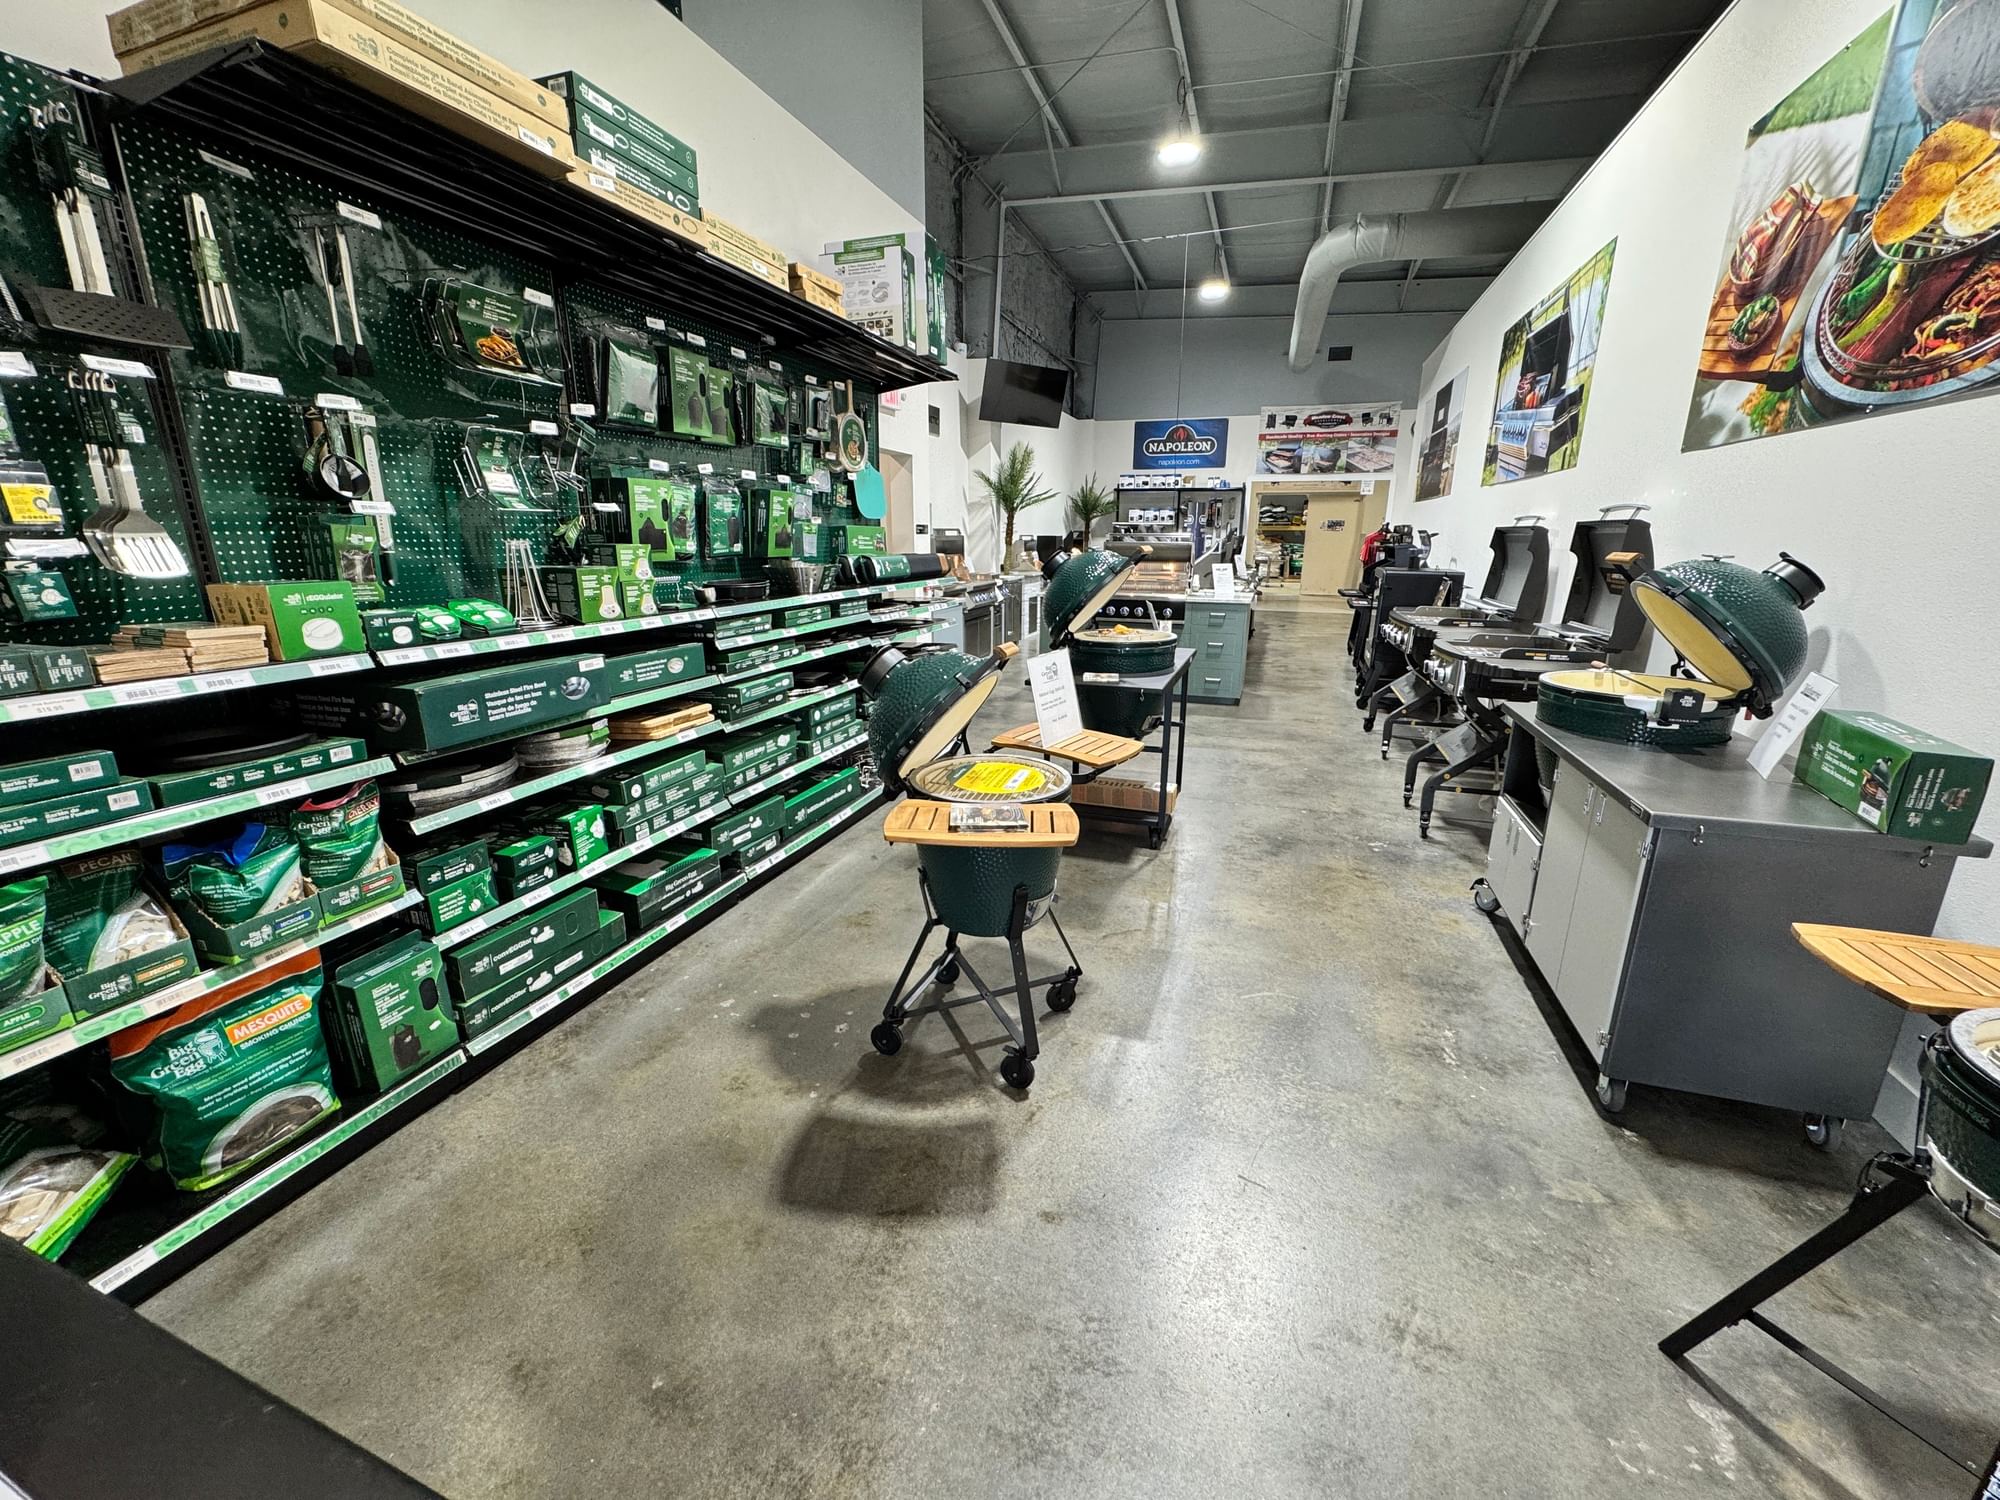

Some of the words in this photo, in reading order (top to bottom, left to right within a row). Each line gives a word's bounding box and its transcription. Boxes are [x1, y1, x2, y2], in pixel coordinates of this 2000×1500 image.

[1149, 441, 1212, 453] NAPOLEON
[484, 689, 509, 699] Stainless
[510, 686, 523, 694] Steel
[534, 681, 547, 689] Bowl
[298, 820, 331, 830] Green
[79, 852, 132, 872] PECAN
[280, 913, 306, 928] HICKORY
[493, 937, 533, 962] convEGGtor
[88, 986, 118, 1000] Green
[100, 980, 117, 991] Big
[491, 987, 527, 1013] convEGGtor
[3, 1012, 31, 1027] APPLE
[233, 1000, 305, 1040] MESQUITE
[240, 1029, 279, 1050] SMOKING
[278, 1011, 312, 1032] CHUNKS
[168, 1041, 198, 1061] Big
[151, 1051, 202, 1079] Green
[175, 1058, 207, 1079] Egg
[204, 1086, 232, 1102] Mesquite
[232, 1078, 248, 1089] wood
[249, 1071, 261, 1080] adds
[265, 1055, 292, 1071] distinctive
[223, 1084, 249, 1099] anything
[249, 1074, 268, 1086] cooked
[279, 1062, 289, 1071] Big
[289, 1054, 306, 1064] Green
